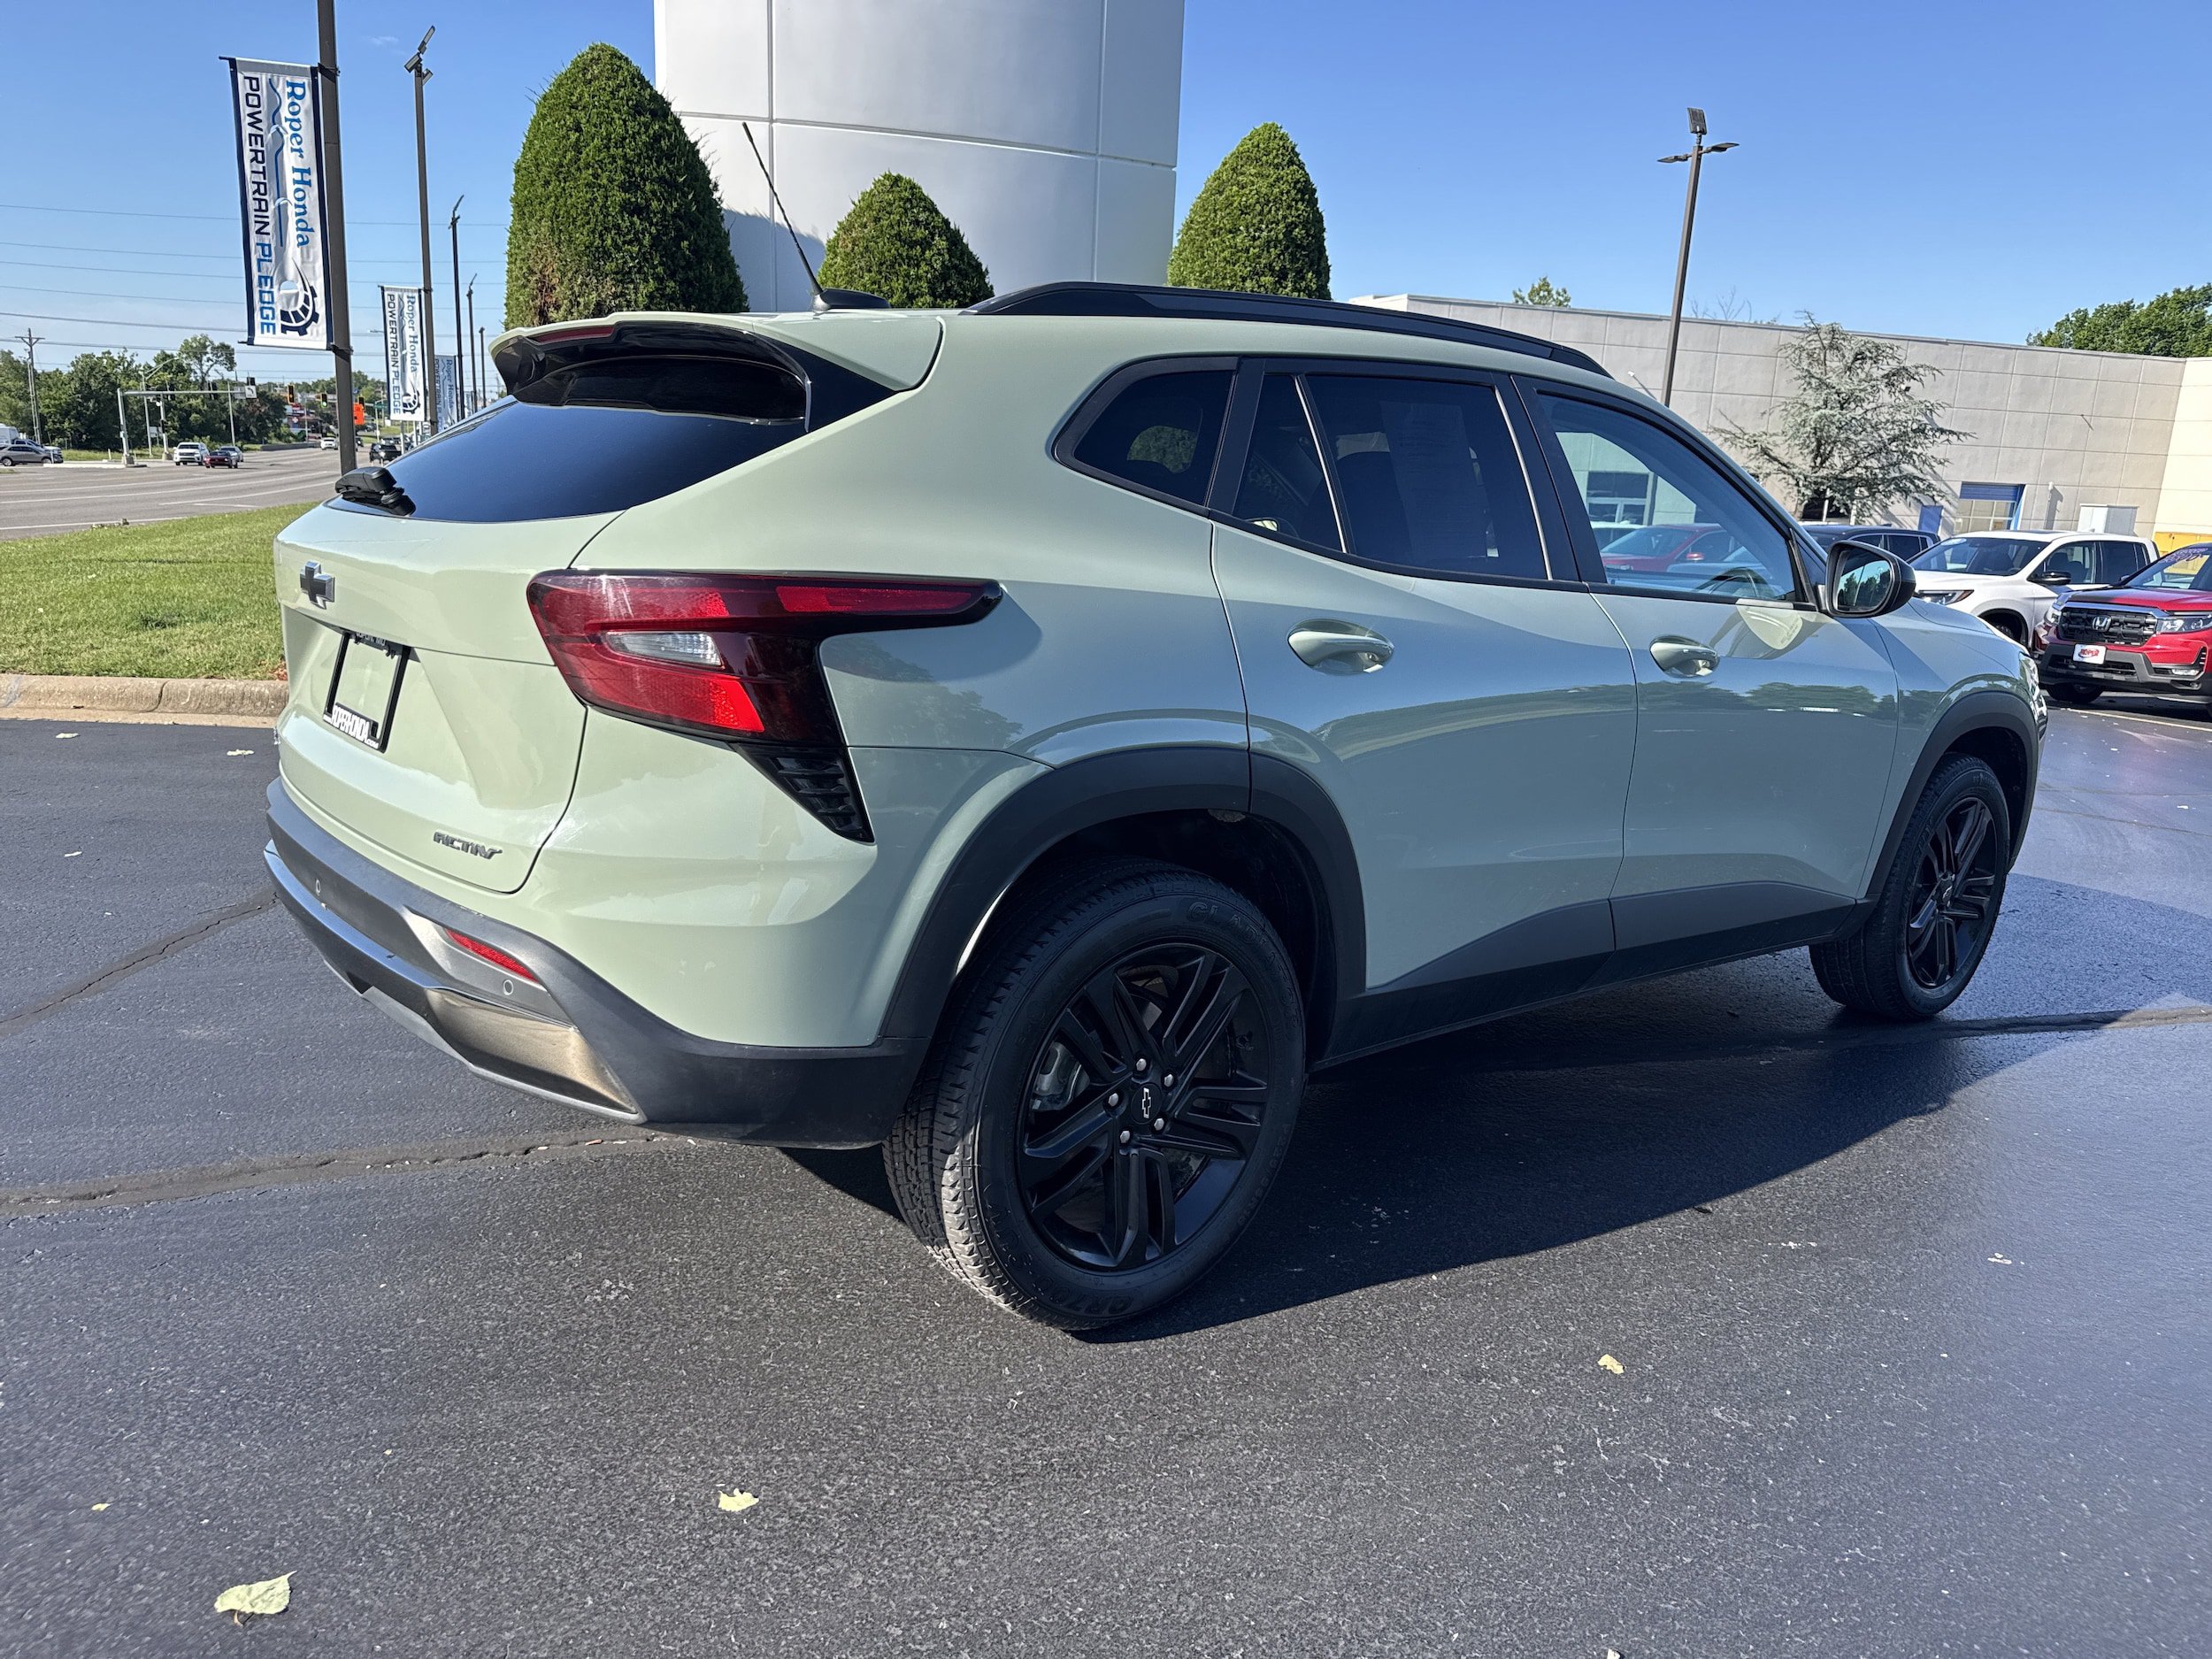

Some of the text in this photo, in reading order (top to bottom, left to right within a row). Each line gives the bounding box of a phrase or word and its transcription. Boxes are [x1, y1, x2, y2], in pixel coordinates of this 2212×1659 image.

[243, 75, 276, 335] POWERTRAIN PLEDGE
[285, 81, 315, 248] Roper Honda
[387, 294, 401, 414] POWERTRAIN PLEDGE
[406, 294, 419, 373] Roper Honda
[434, 832, 503, 859] ACTIV
